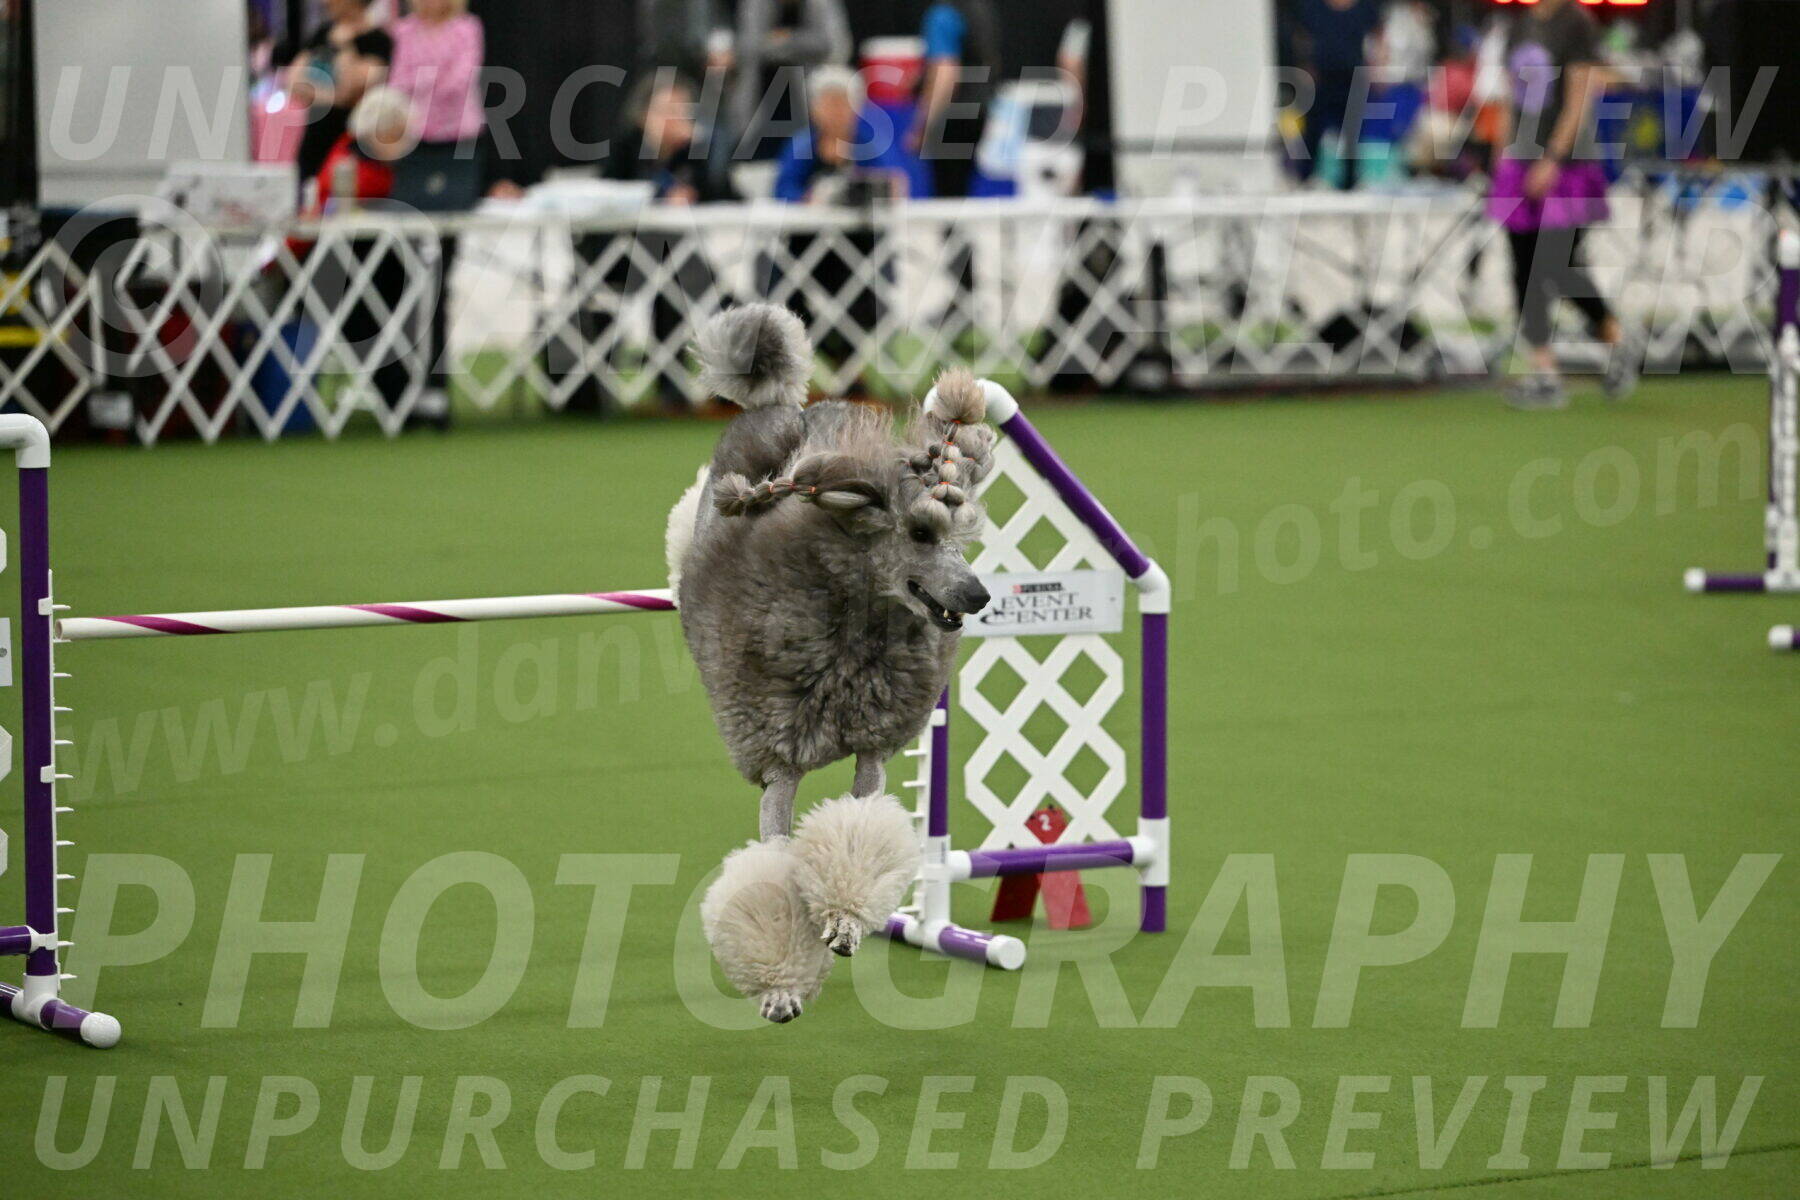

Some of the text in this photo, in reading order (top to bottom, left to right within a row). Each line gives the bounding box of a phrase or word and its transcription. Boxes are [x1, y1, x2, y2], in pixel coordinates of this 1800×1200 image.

[1001, 592, 1079, 610] EVENT
[980, 607, 1093, 626] CENTER
[1039, 814, 1052, 831] 2
